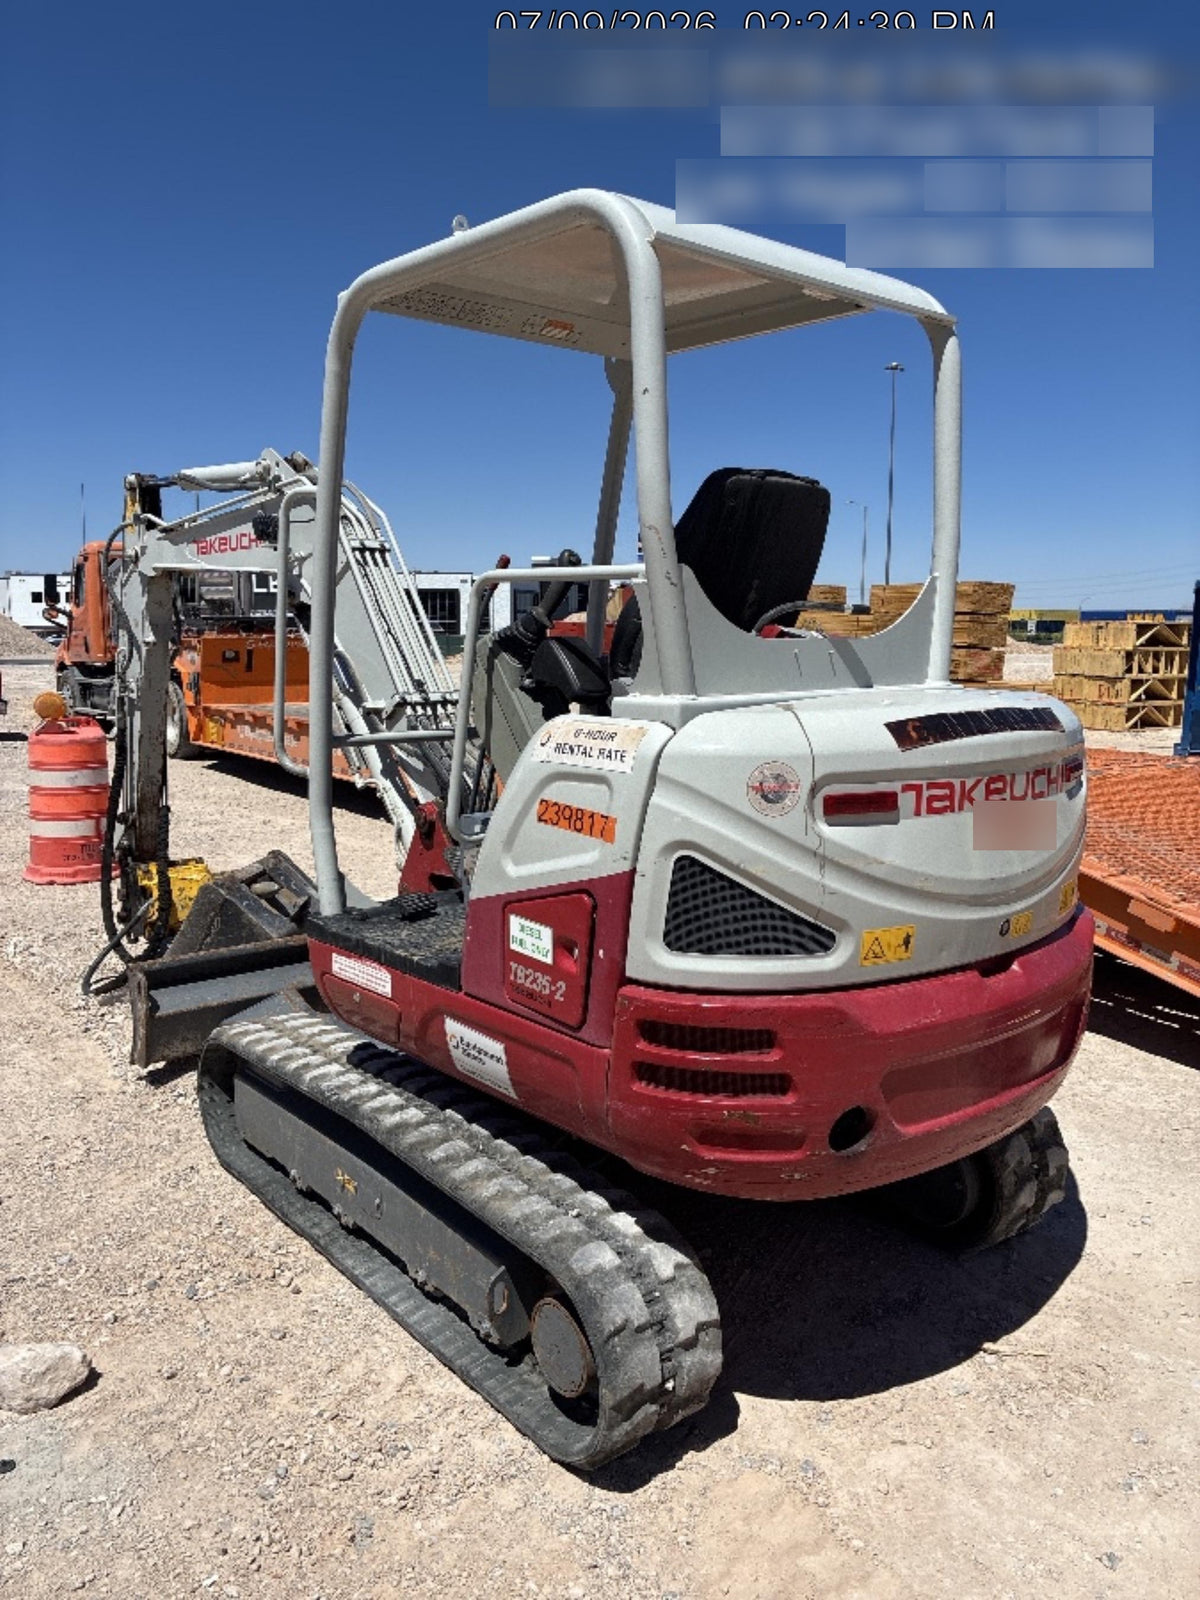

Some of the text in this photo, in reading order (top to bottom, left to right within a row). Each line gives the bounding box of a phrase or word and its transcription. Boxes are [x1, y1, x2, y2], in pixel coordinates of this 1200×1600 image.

[554, 742, 627, 764] RENTAL RATE
[537, 798, 610, 839] 239817
